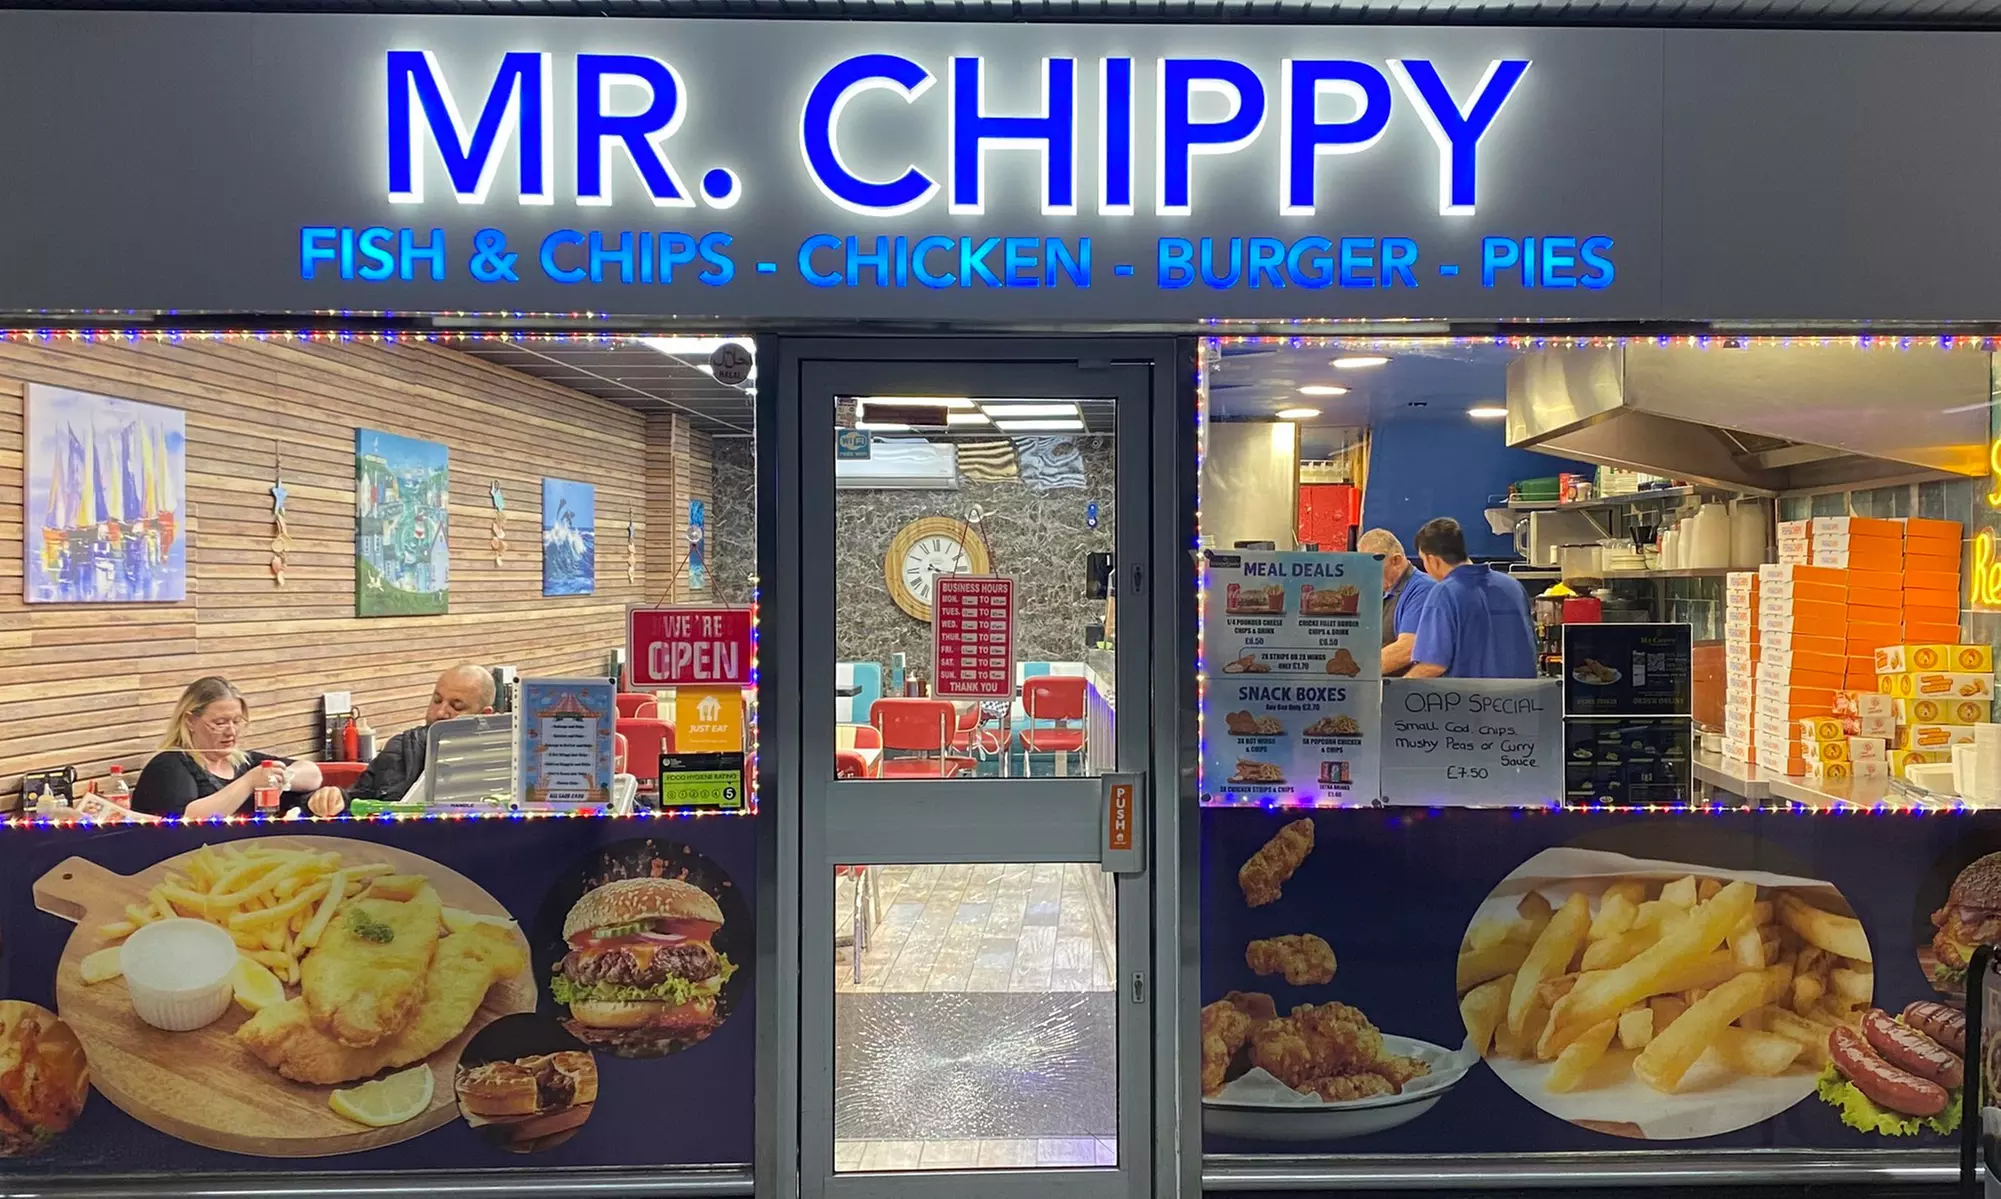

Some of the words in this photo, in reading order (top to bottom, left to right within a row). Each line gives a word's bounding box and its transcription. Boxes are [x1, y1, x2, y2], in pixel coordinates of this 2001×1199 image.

[387, 50, 741, 210] MR.
[800, 53, 1533, 216] CHIPPY
[300, 226, 446, 282] FISH
[469, 227, 519, 284] &
[540, 229, 736, 287] CHIPS
[756, 261, 777, 274] -
[798, 234, 1091, 289] CHICKEN
[1114, 263, 1135, 277] -
[1157, 236, 1419, 289] BURGER
[1438, 263, 1459, 277] -
[1481, 236, 1616, 289] PIES
[1244, 562, 1287, 577] MEAL
[1292, 563, 1344, 578] DEALS
[942, 583, 980, 593] BUSINESS
[981, 584, 1008, 594] HOURS
[980, 596, 990, 604] TO
[663, 615, 722, 638] WE'RE
[979, 621, 989, 630] TO
[979, 634, 989, 642] TO
[648, 641, 739, 681] OPEN
[978, 672, 988, 680] TO
[949, 682, 978, 692] THANK
[980, 682, 998, 693] YOU
[1239, 687, 1292, 701] SNACK
[1297, 687, 1346, 701] BOXES
[1469, 694, 1544, 714] SPECIAL
[688, 725, 710, 733] JUST
[711, 725, 728, 733] EAT
[1394, 720, 1439, 732] Small
[1446, 736, 1475, 751] Peas
[1481, 742, 1494, 750] or
[1500, 739, 1535, 757] Curry
[1501, 755, 1539, 768] Sauce
[1447, 765, 1488, 780] £7.50
[726, 789, 733, 798] 5
[1116, 788, 1126, 830] PUSH
